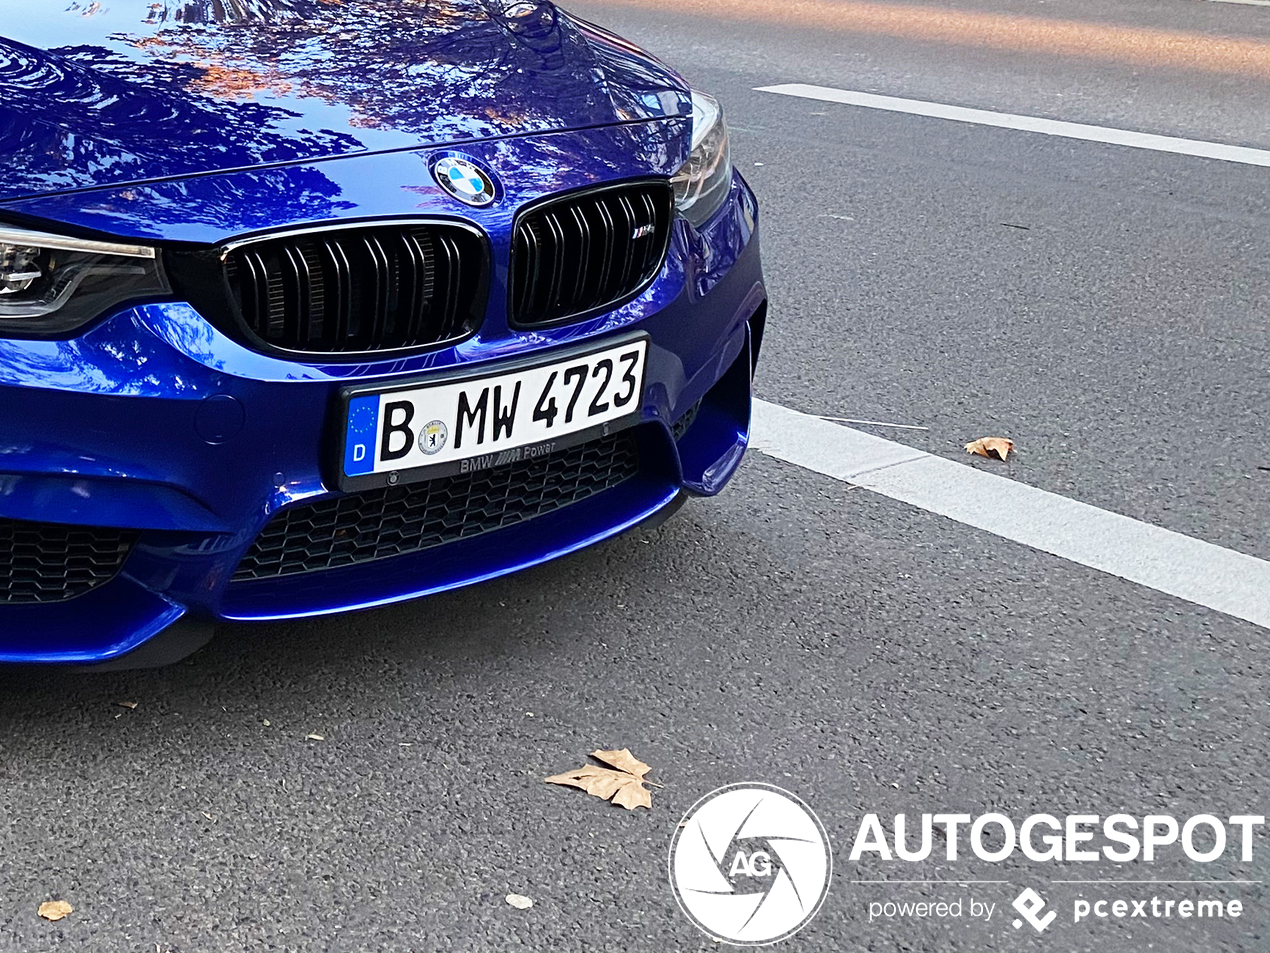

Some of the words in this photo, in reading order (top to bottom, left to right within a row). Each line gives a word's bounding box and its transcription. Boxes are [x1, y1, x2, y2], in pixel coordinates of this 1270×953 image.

[353, 444, 365, 462] D
[380, 400, 415, 462] B
[454, 380, 522, 449] MW
[532, 350, 640, 428] 4723
[460, 454, 494, 474] BMW
[524, 442, 556, 460] Power
